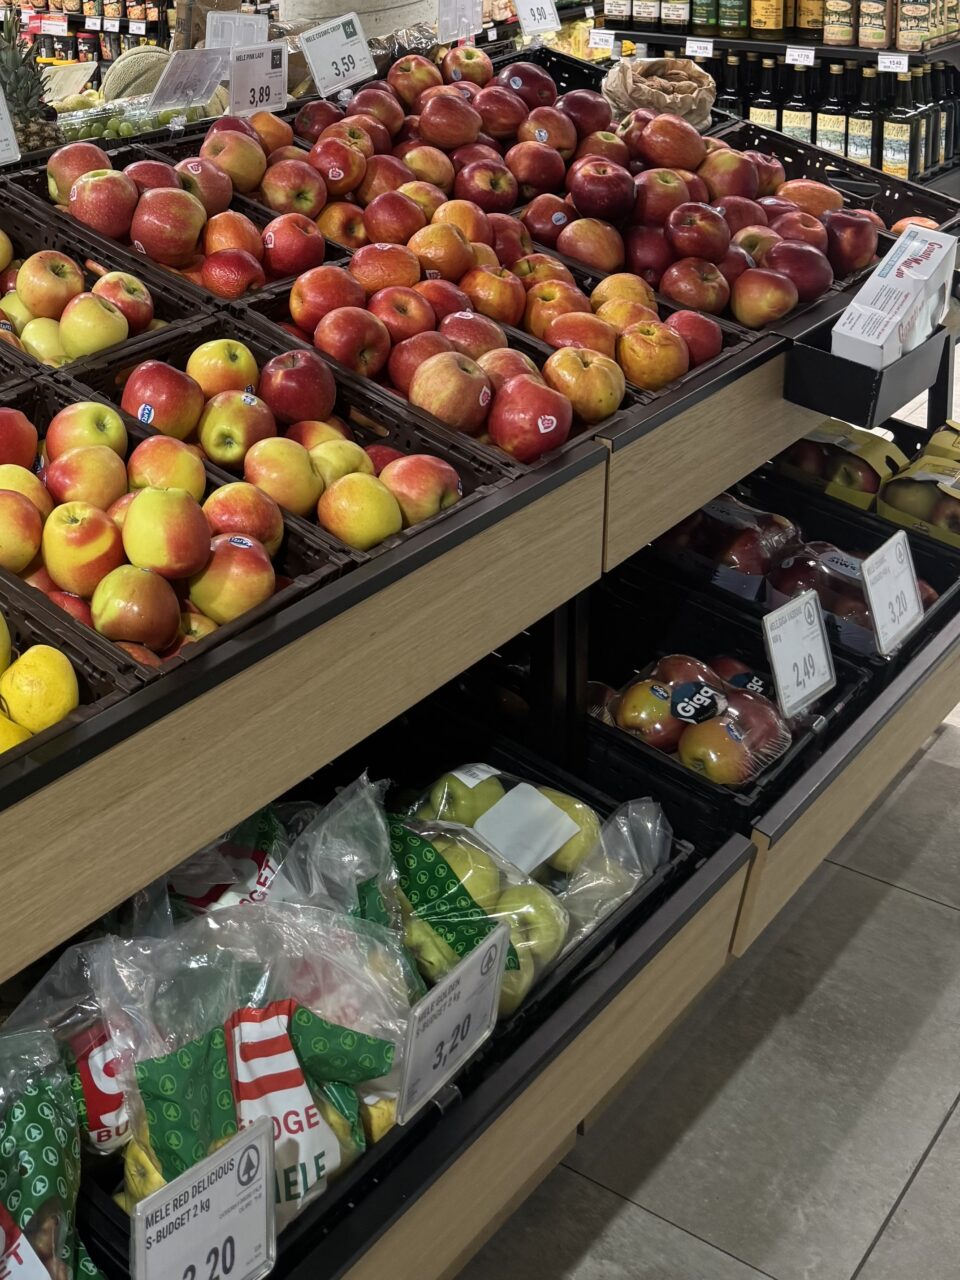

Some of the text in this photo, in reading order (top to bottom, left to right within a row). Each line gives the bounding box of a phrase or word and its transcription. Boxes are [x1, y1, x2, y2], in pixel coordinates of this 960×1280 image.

[530, 6, 547, 23] 9,90
[331, 54, 356, 78] 3,59
[249, 85, 271, 108] 3,89
[887, 590, 908, 624] 3,20
[792, 653, 816, 689] 2,49
[432, 1013, 472, 1070] 3,20
[145, 1203, 171, 1230] MELE
[172, 1191, 190, 1212] RED
[191, 1158, 235, 1199] DELICIOUS
[145, 1208, 191, 1250] S-BUDGET
[192, 1204, 198, 1218] 2
[200, 1198, 211, 1213] kg
